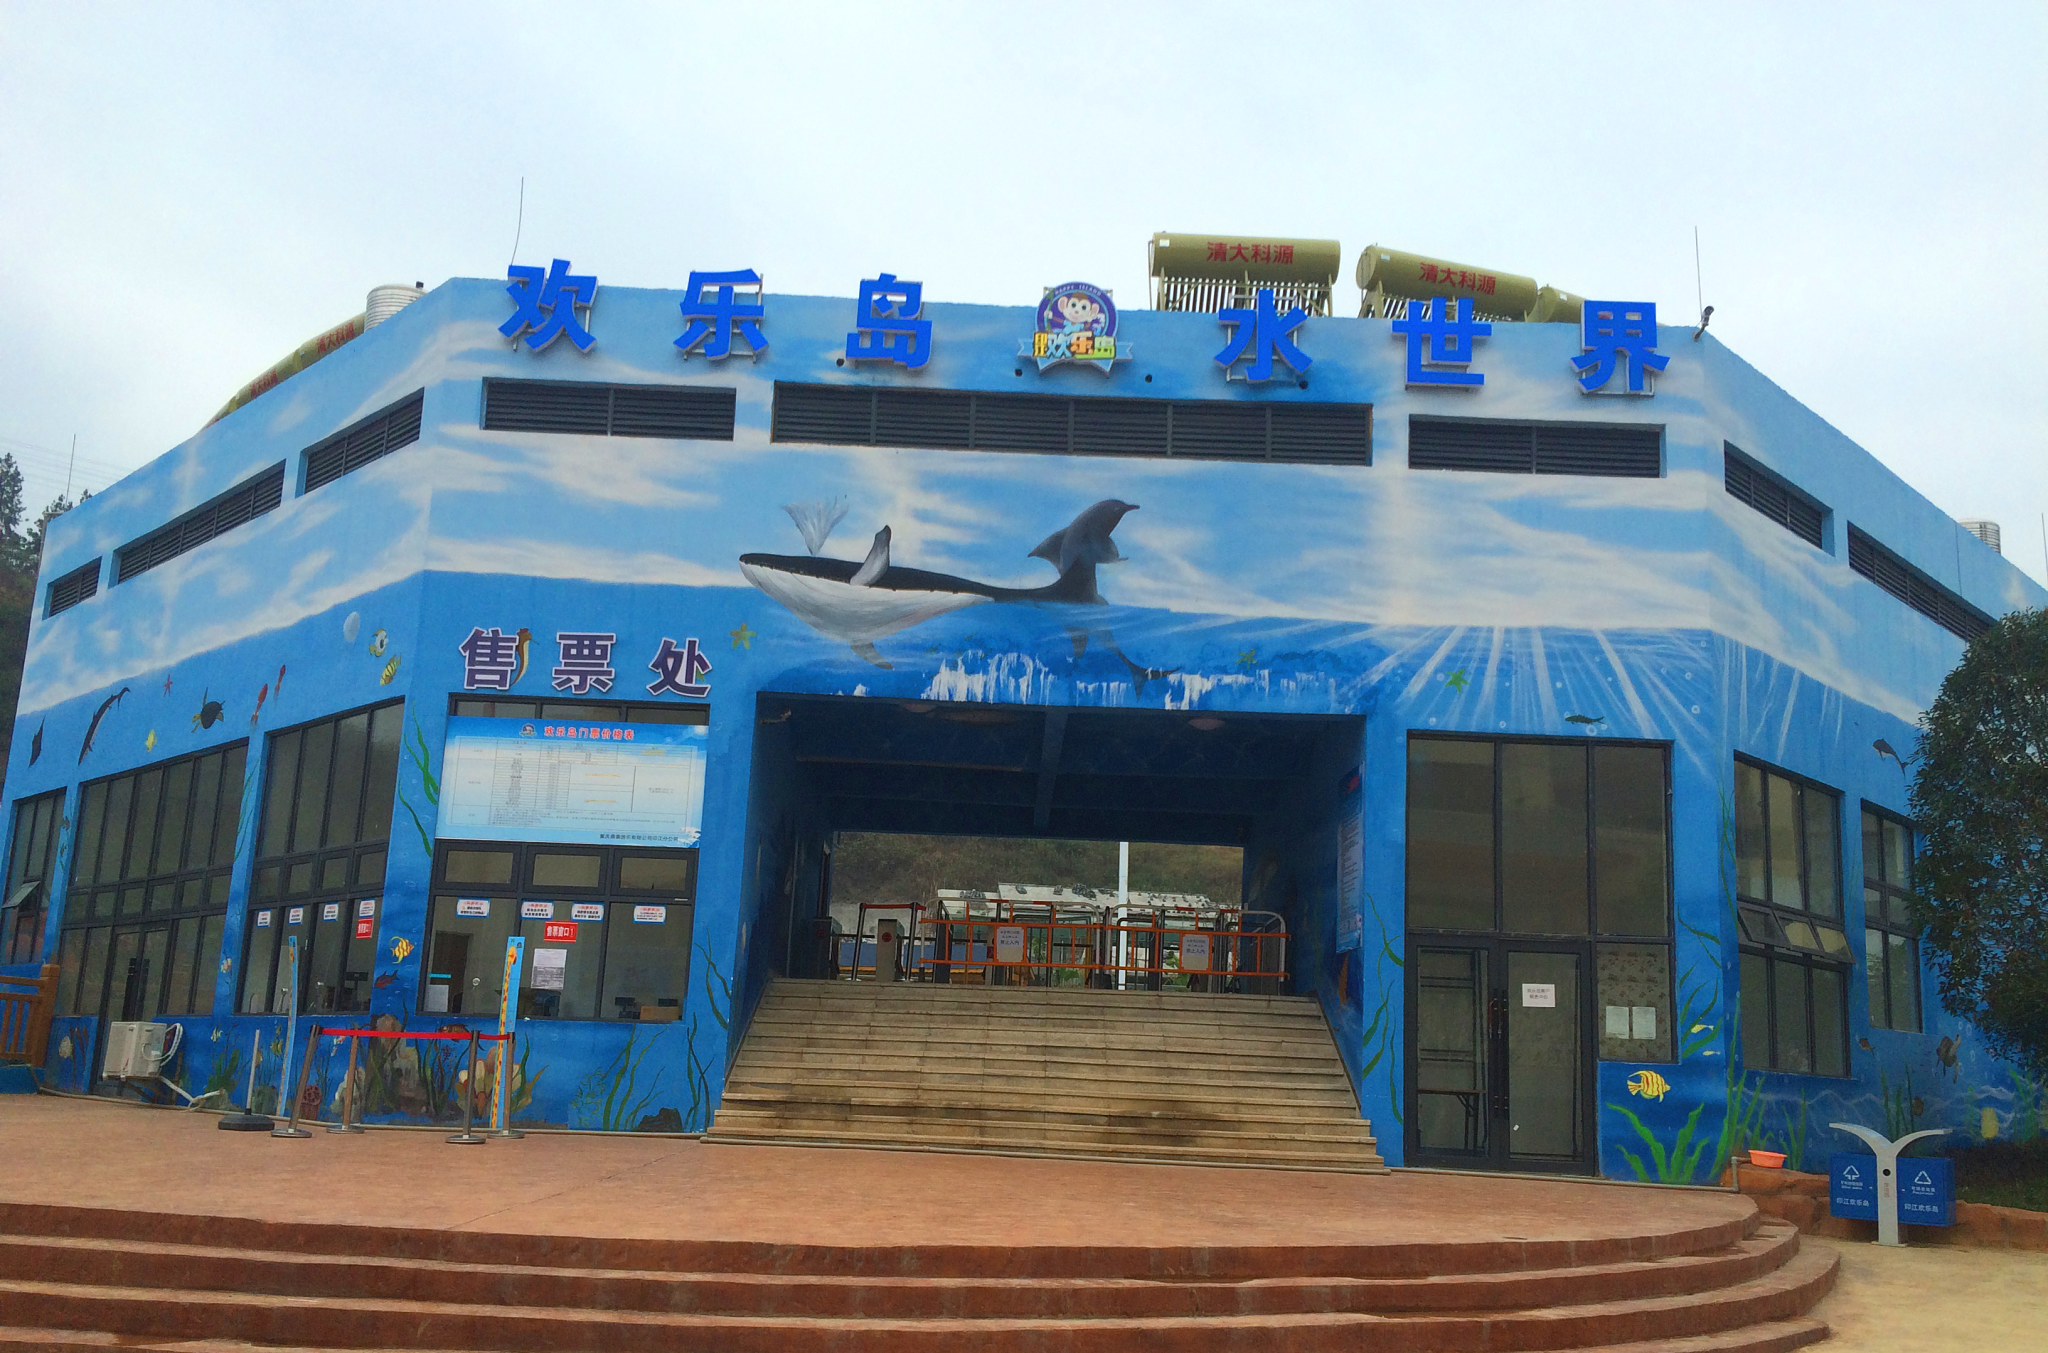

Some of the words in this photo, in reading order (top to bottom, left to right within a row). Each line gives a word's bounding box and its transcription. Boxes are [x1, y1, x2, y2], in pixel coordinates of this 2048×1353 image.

[1207, 242, 1295, 265] 清大科源
[1419, 262, 1497, 295] 清大科源
[498, 258, 933, 371] 欢乐岛
[1213, 289, 1670, 395] 水世界
[459, 627, 712, 698] 售票处
[544, 726, 635, 740] 欢乐岛门票价格表
[1836, 1197, 1870, 1207] 印江欢乐岛
[1904, 1203, 1939, 1213] 印江欢乐岛
